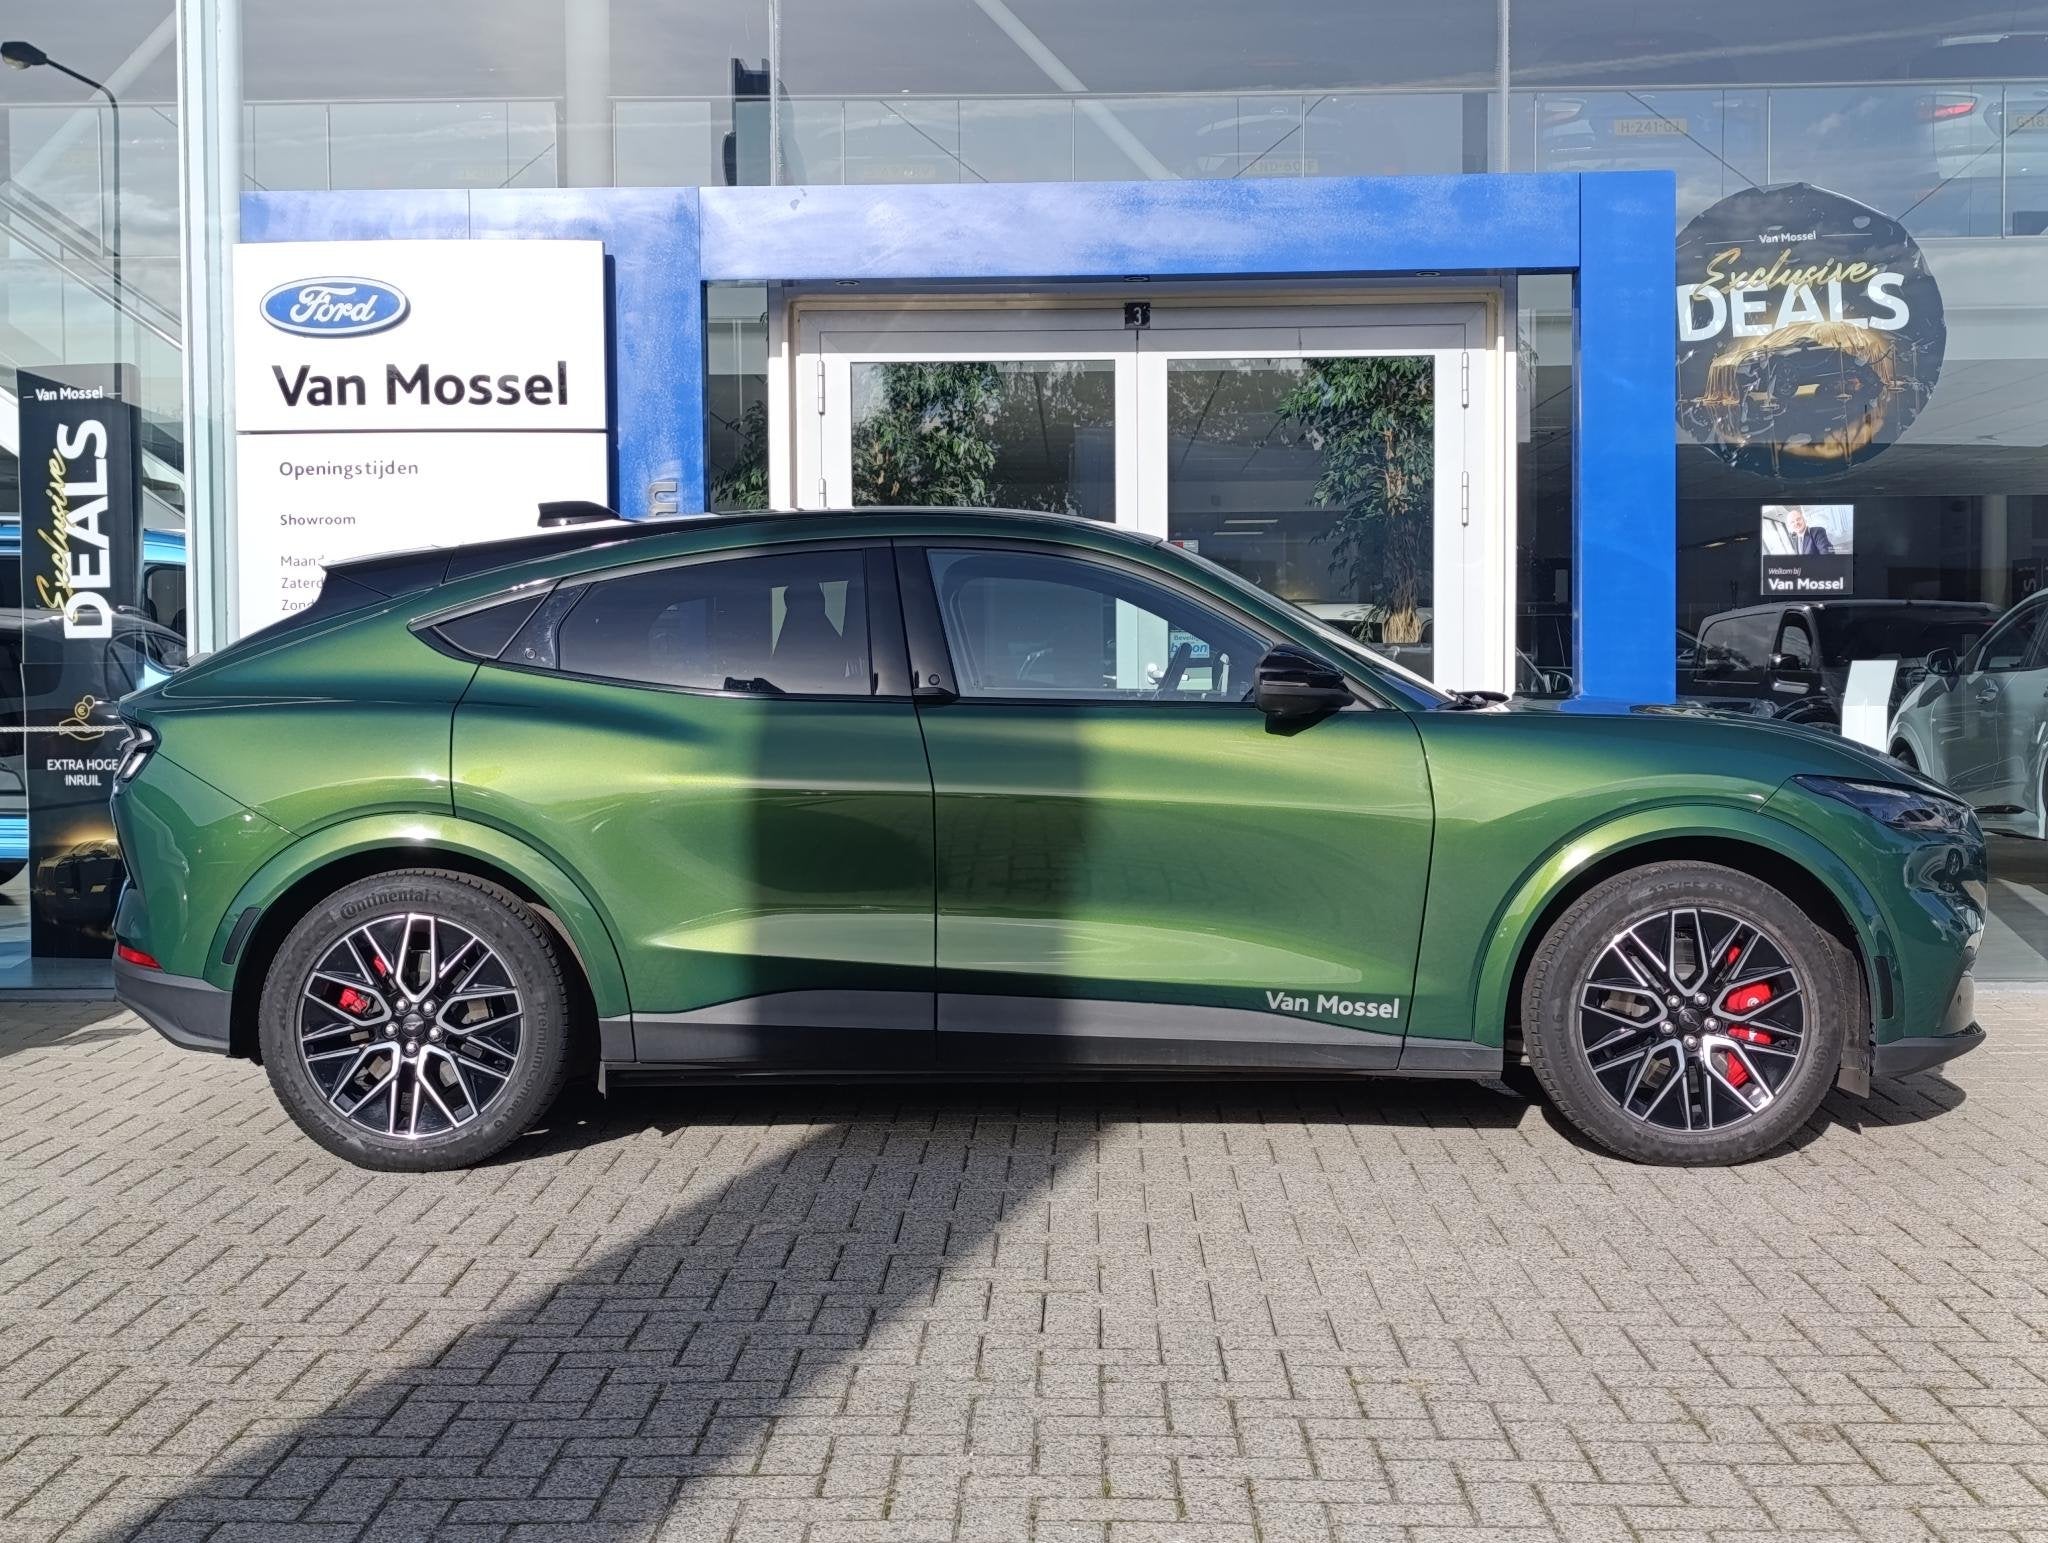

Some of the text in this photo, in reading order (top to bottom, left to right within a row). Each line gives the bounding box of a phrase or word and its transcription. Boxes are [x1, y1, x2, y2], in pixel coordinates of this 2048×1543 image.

[1758, 230, 1817, 244] Van Mossel
[1693, 247, 1879, 300] Exclusive
[289, 286, 380, 323] Ford
[1676, 272, 1910, 342] DEALS
[1133, 307, 1142, 325] 3
[35, 386, 104, 401] Van Mossel
[271, 360, 568, 407] Van Mossel
[279, 460, 418, 480] Openingstijden
[56, 419, 113, 639] DEALS
[280, 514, 356, 526] Showroom
[36, 448, 78, 624] Exclusive
[1768, 567, 1793, 576] Welkom
[1768, 577, 1844, 590] Van Mossel
[47, 759, 119, 771] EXTRA HOGE
[64, 774, 102, 786] INRUIL
[340, 888, 430, 920] Continental
[1265, 990, 1400, 1019] Van Mossel
